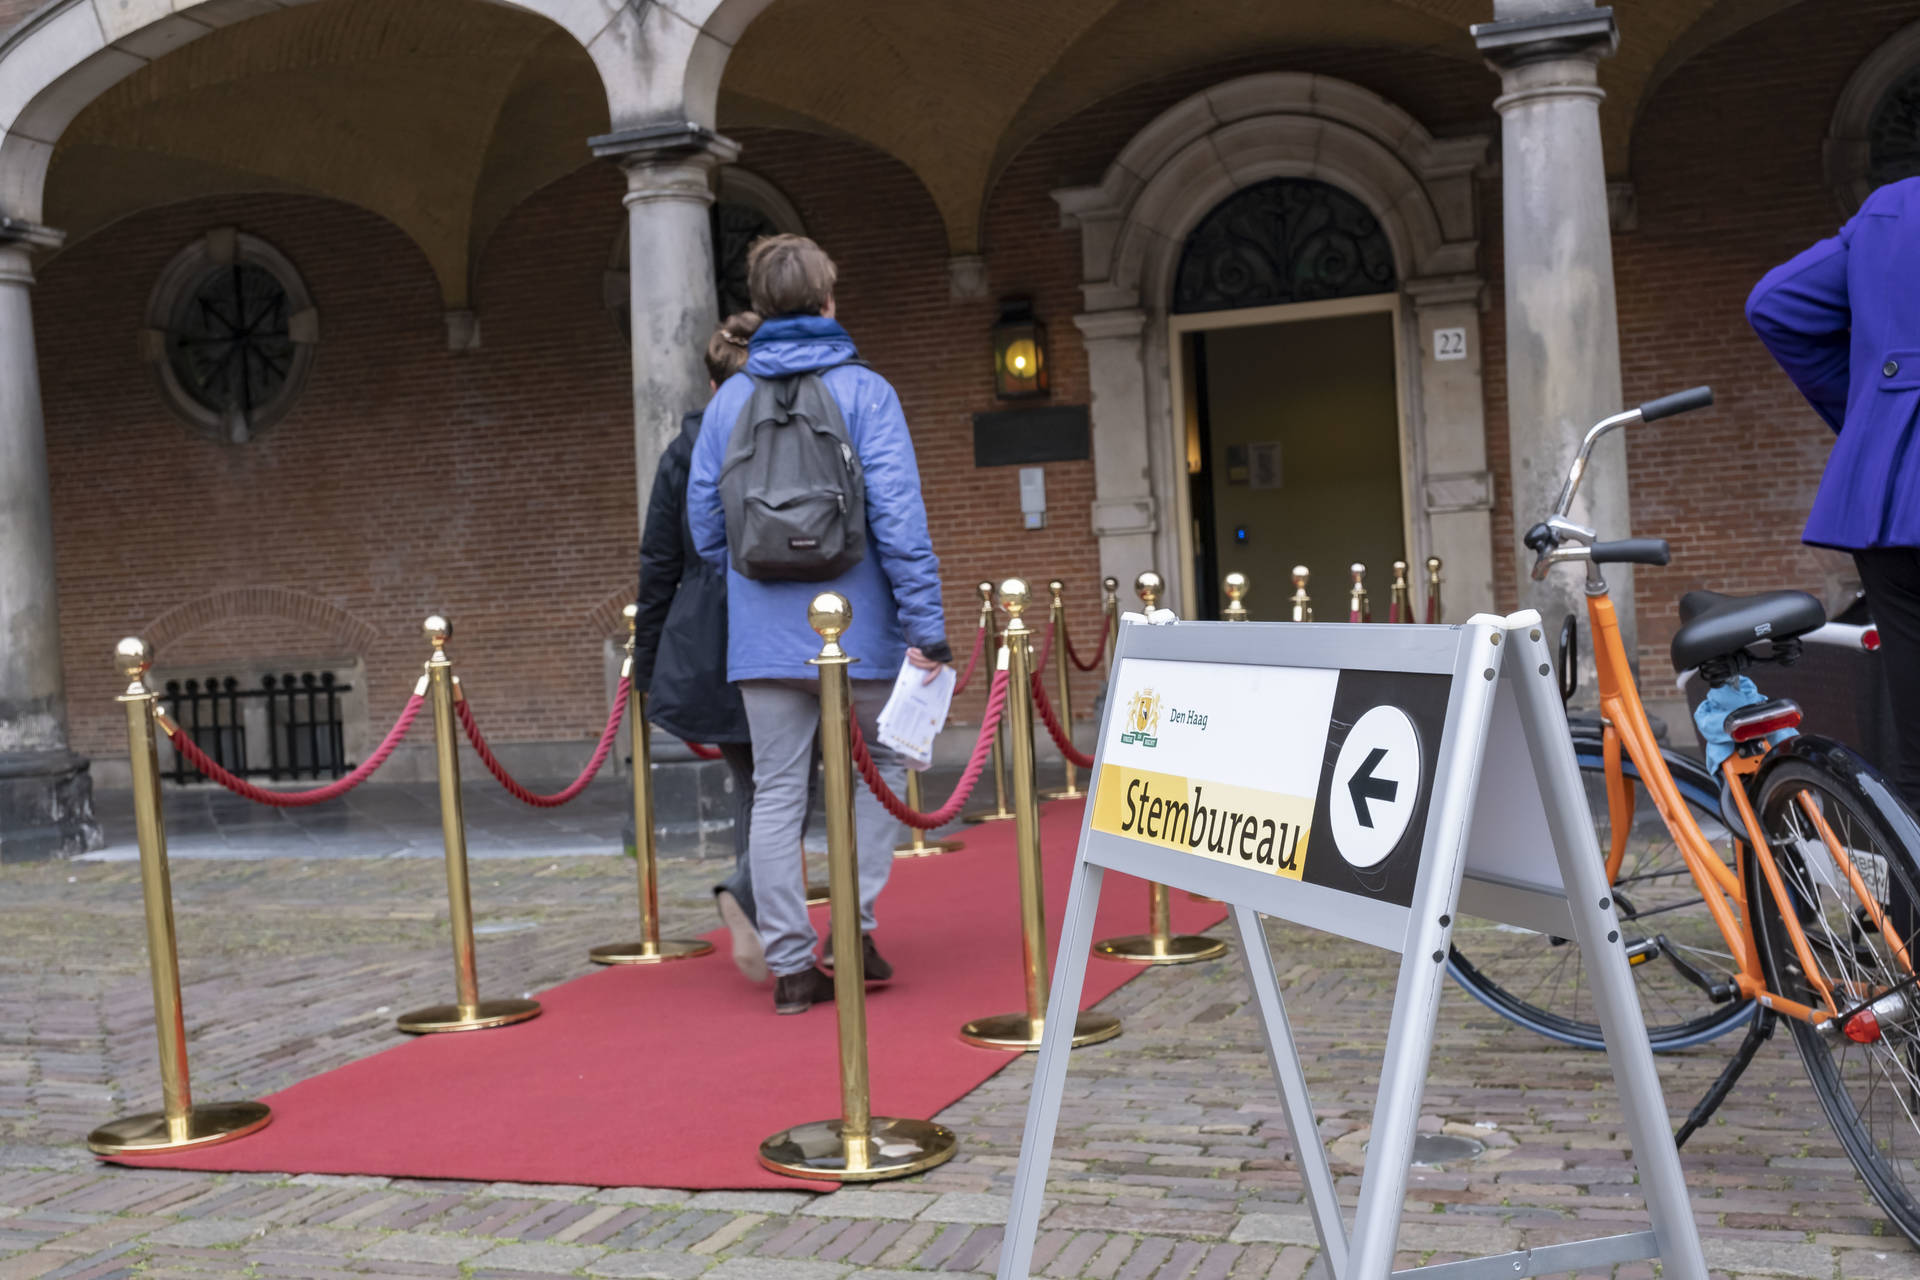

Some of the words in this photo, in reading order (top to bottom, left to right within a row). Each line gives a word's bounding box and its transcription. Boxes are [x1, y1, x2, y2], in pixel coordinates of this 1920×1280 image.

[1440, 332, 1462, 354] 22
[1170, 708, 1186, 724] Den
[1186, 709, 1208, 731] Haag
[1121, 778, 1301, 871] Stembureau
